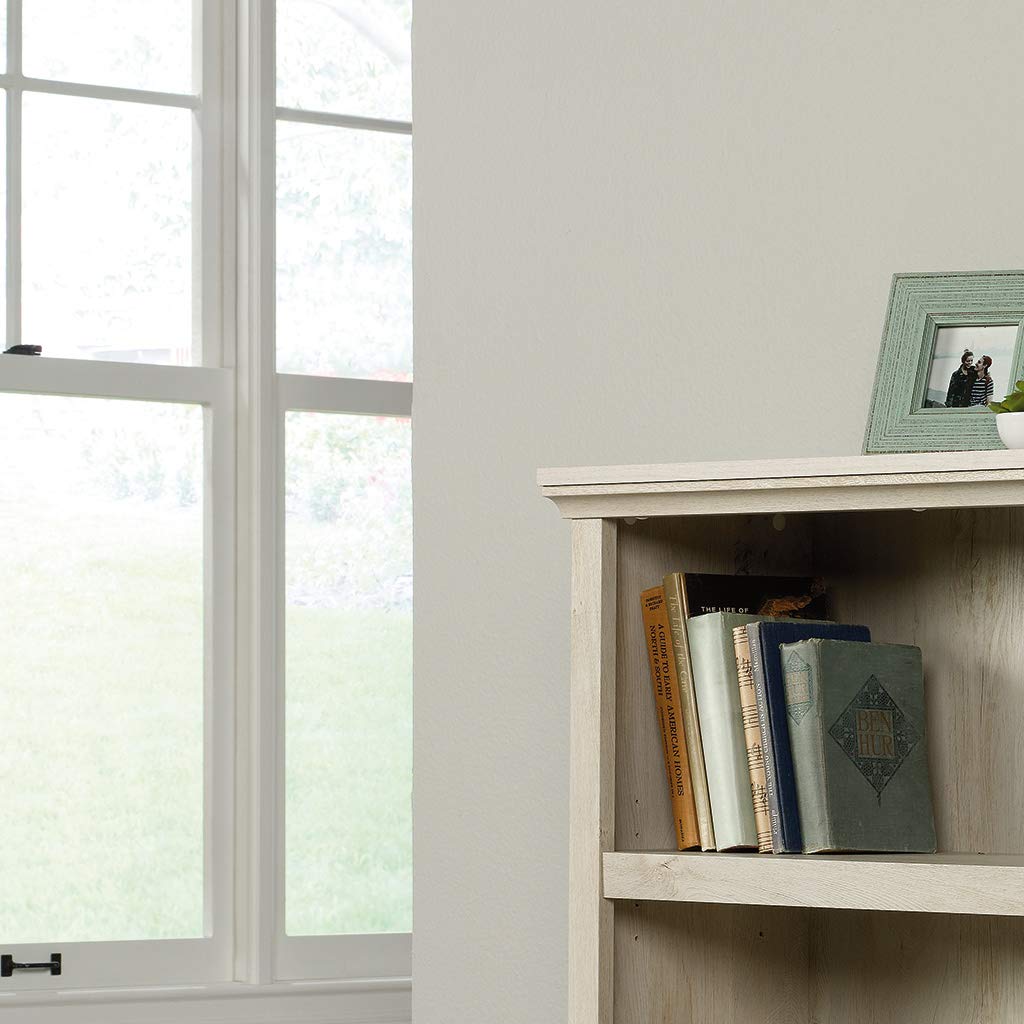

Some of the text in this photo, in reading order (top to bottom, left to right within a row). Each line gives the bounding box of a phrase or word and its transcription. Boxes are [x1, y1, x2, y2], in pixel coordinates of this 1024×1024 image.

[659, 631, 669, 660] GUIDE
[674, 640, 684, 648] of
[649, 625, 659, 656] NORTH
[654, 666, 663, 696] SOUTH
[662, 661, 670, 674] TO
[664, 675, 673, 702] EARLY
[667, 705, 680, 757] AMERICAN
[858, 710, 892, 732] BEN
[858, 733, 896, 756] HUR
[674, 761, 684, 796] HOMES
